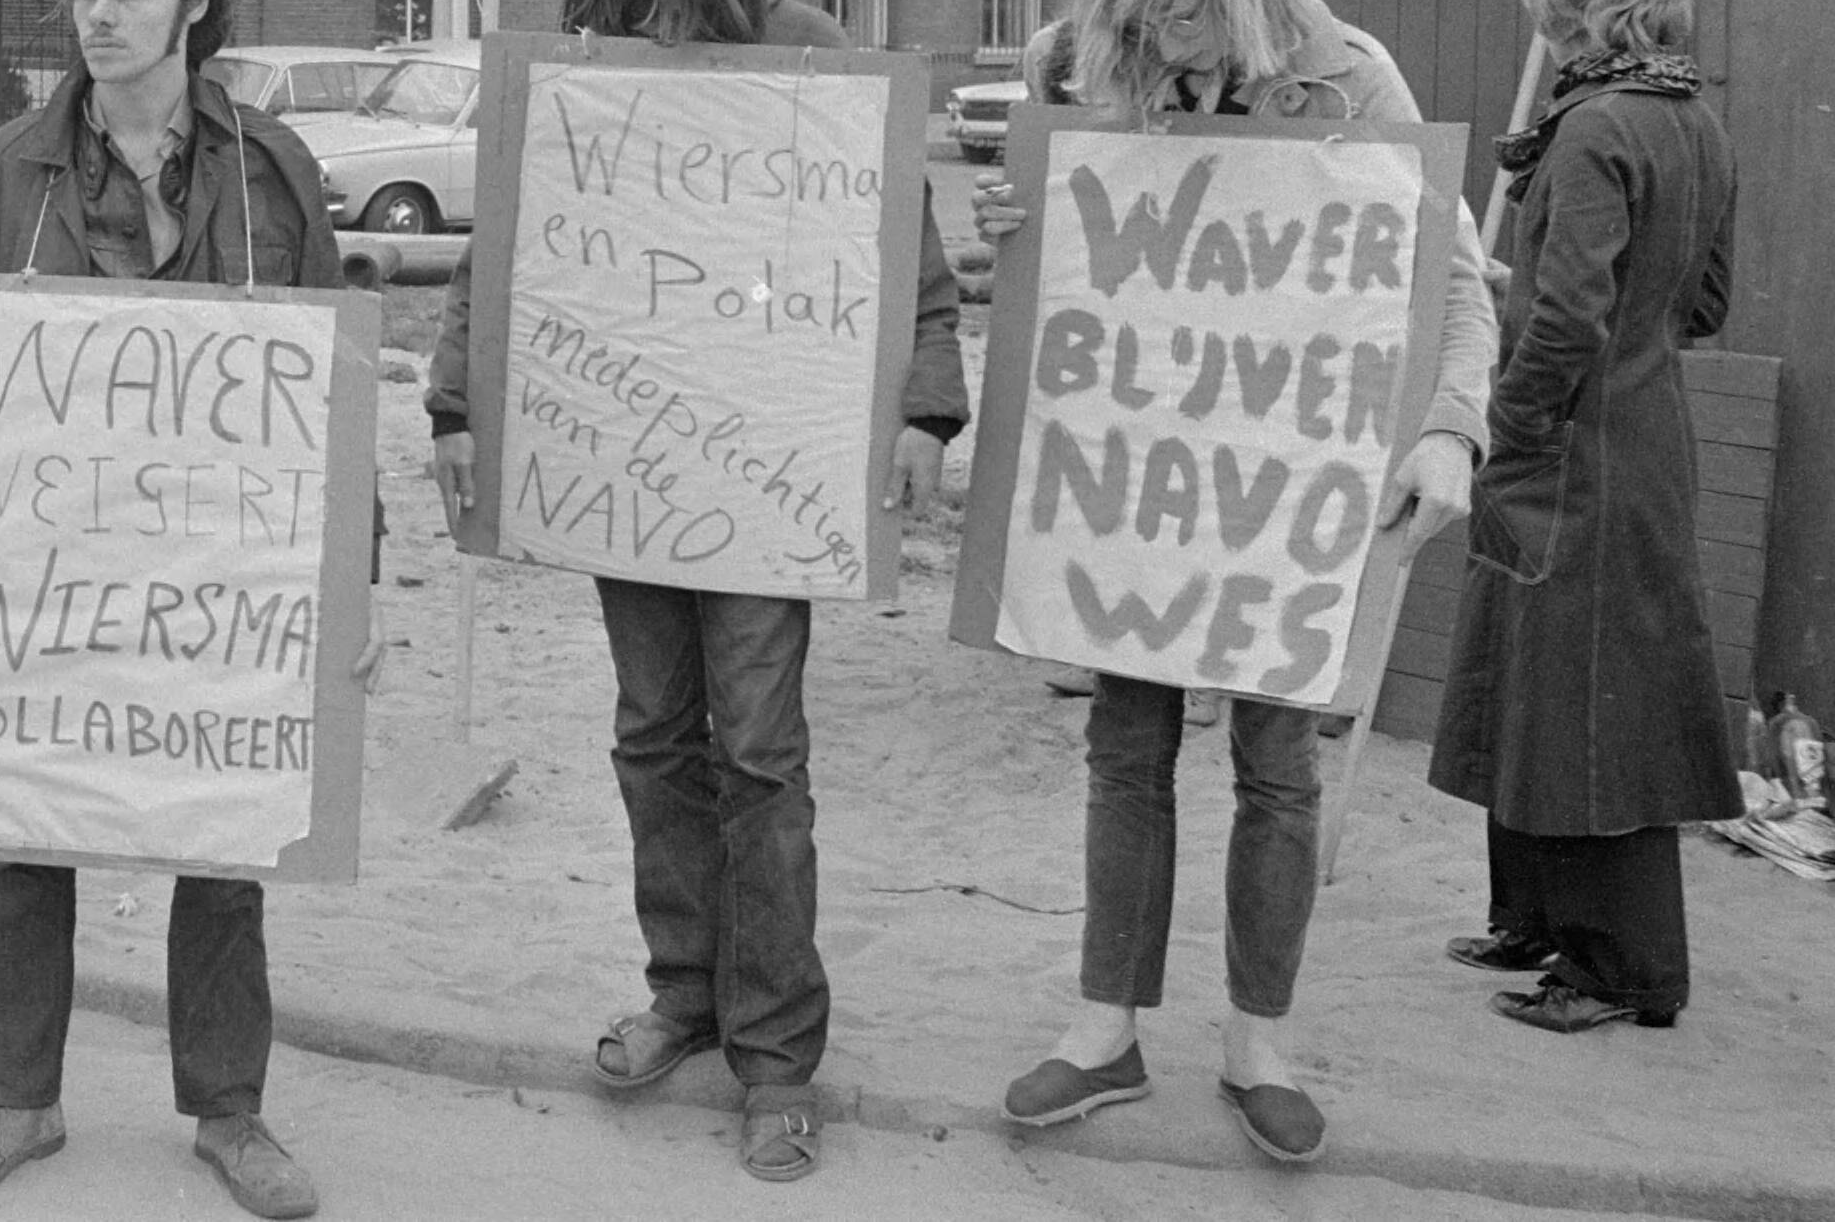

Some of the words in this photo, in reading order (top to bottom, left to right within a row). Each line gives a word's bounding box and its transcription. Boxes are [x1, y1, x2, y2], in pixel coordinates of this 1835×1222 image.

[552, 88, 882, 204] Wiersma
[543, 212, 618, 268] en
[639, 248, 869, 339] Polak
[1068, 154, 1407, 299] WAVER
[516, 450, 736, 564] NAVO
[519, 376, 598, 457] van
[624, 451, 692, 513] de
[528, 311, 864, 586] medeplichtigen
[1031, 419, 1370, 577] NAVO
